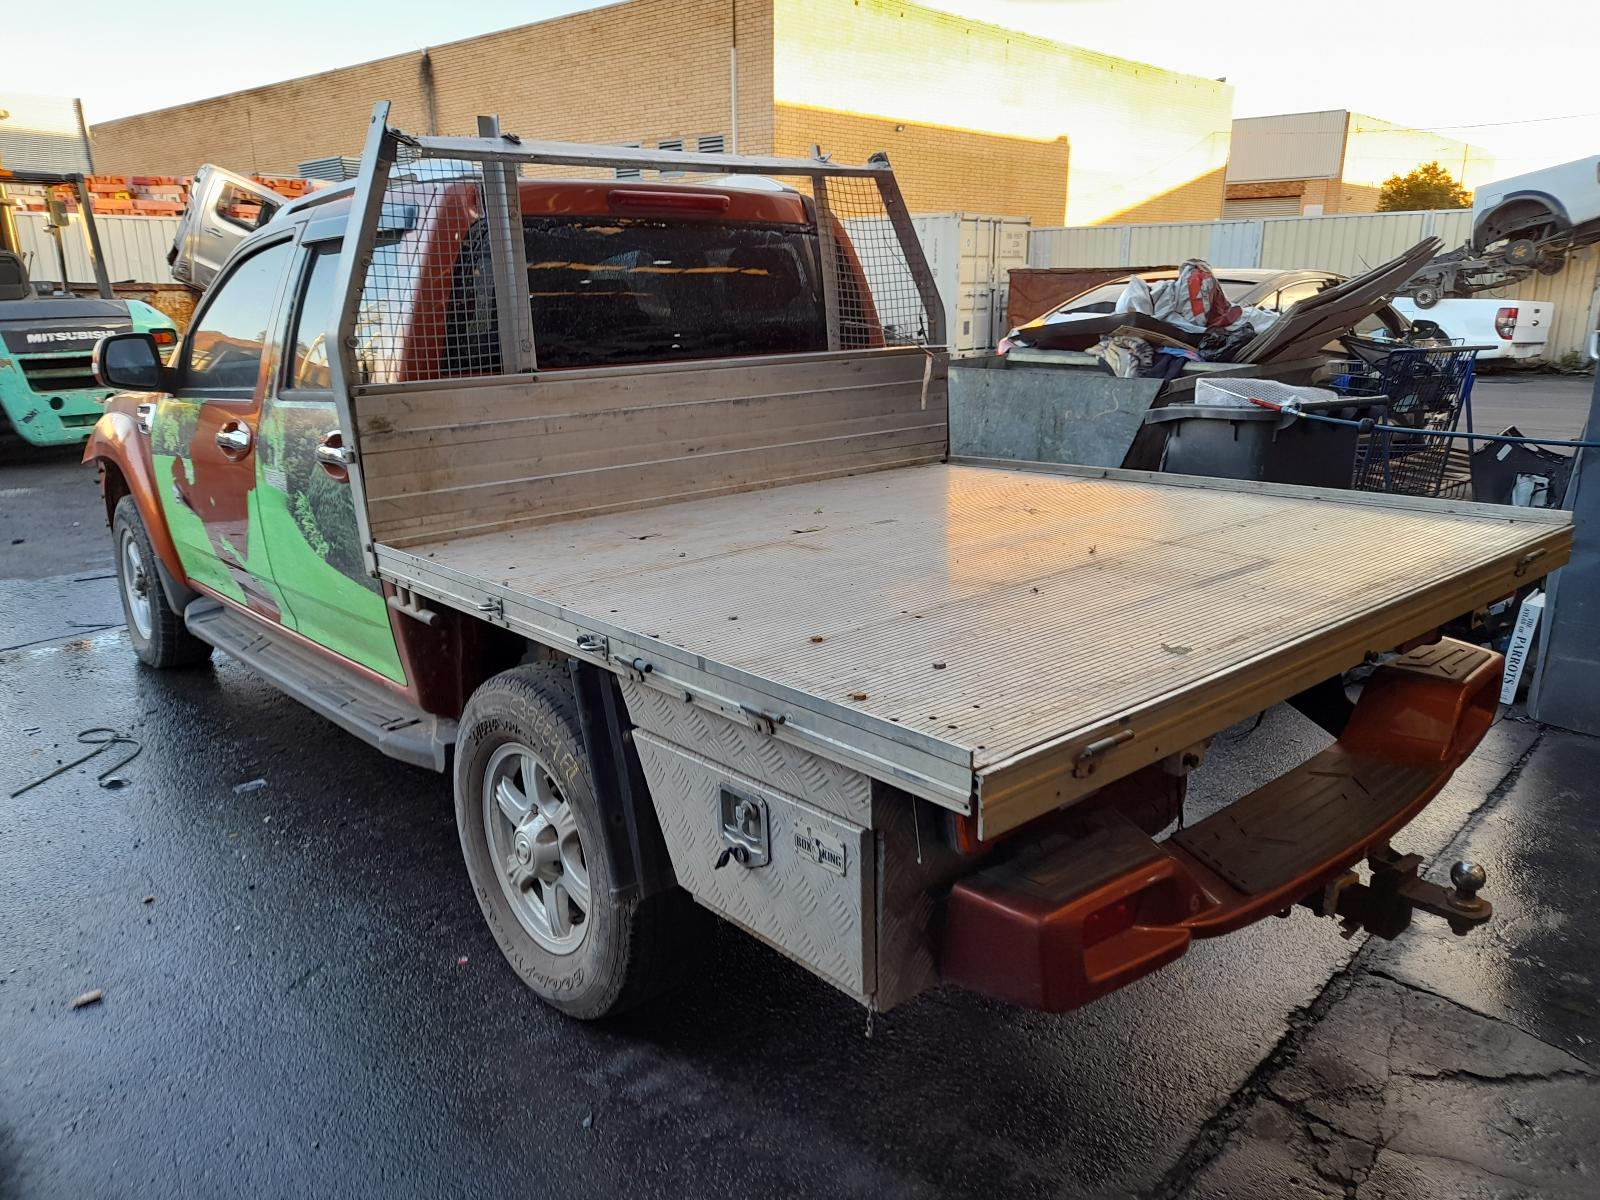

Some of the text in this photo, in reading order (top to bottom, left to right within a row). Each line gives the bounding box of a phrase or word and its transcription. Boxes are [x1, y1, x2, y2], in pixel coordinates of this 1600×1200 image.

[1503, 636, 1526, 685] PARROTS
[796, 836, 842, 867] BOX KING
